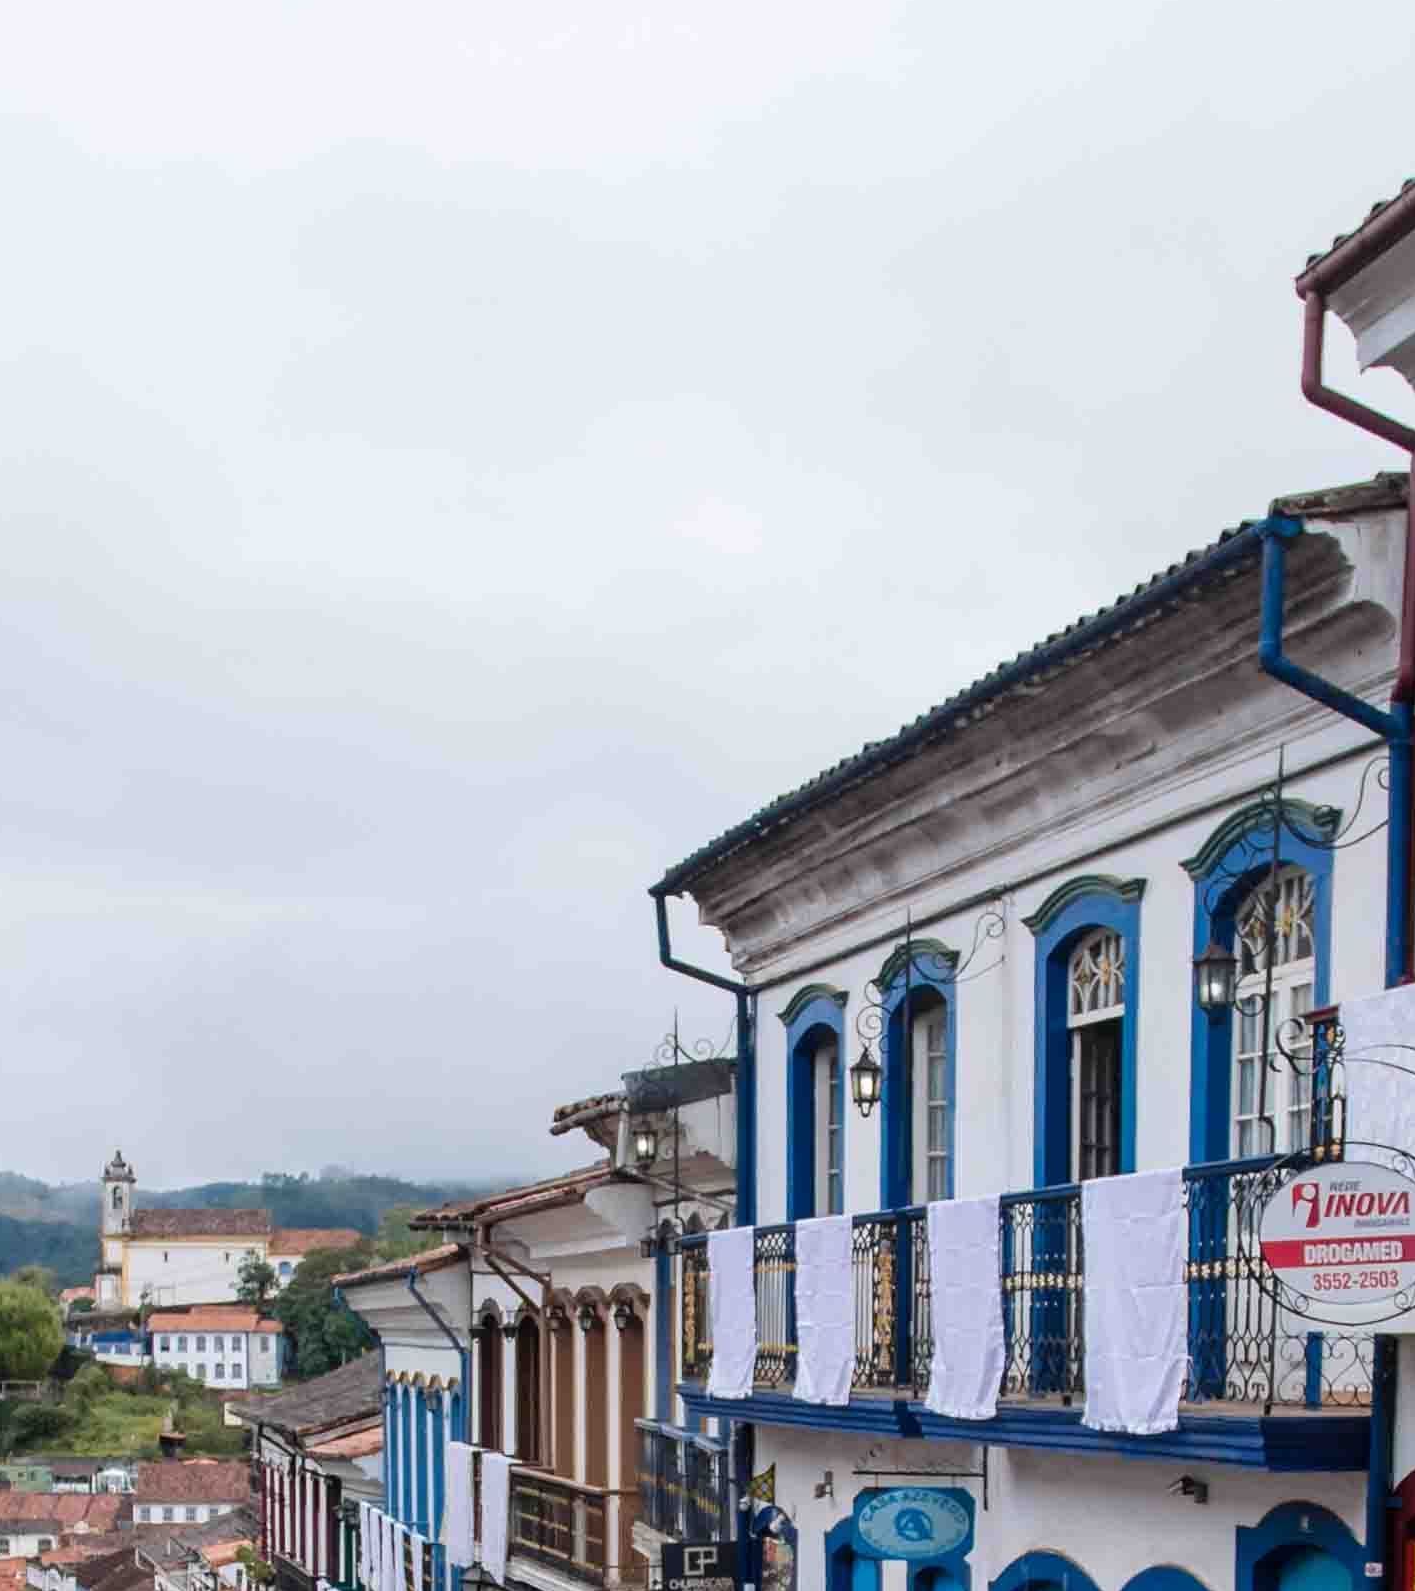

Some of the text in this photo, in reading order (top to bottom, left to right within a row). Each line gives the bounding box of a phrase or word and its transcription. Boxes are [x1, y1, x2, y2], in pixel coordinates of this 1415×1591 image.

[1324, 1192, 1410, 1217] INOVA
[1304, 1241, 1402, 1264] DROGAMED
[1313, 1270, 1399, 1291] 3552-2503
